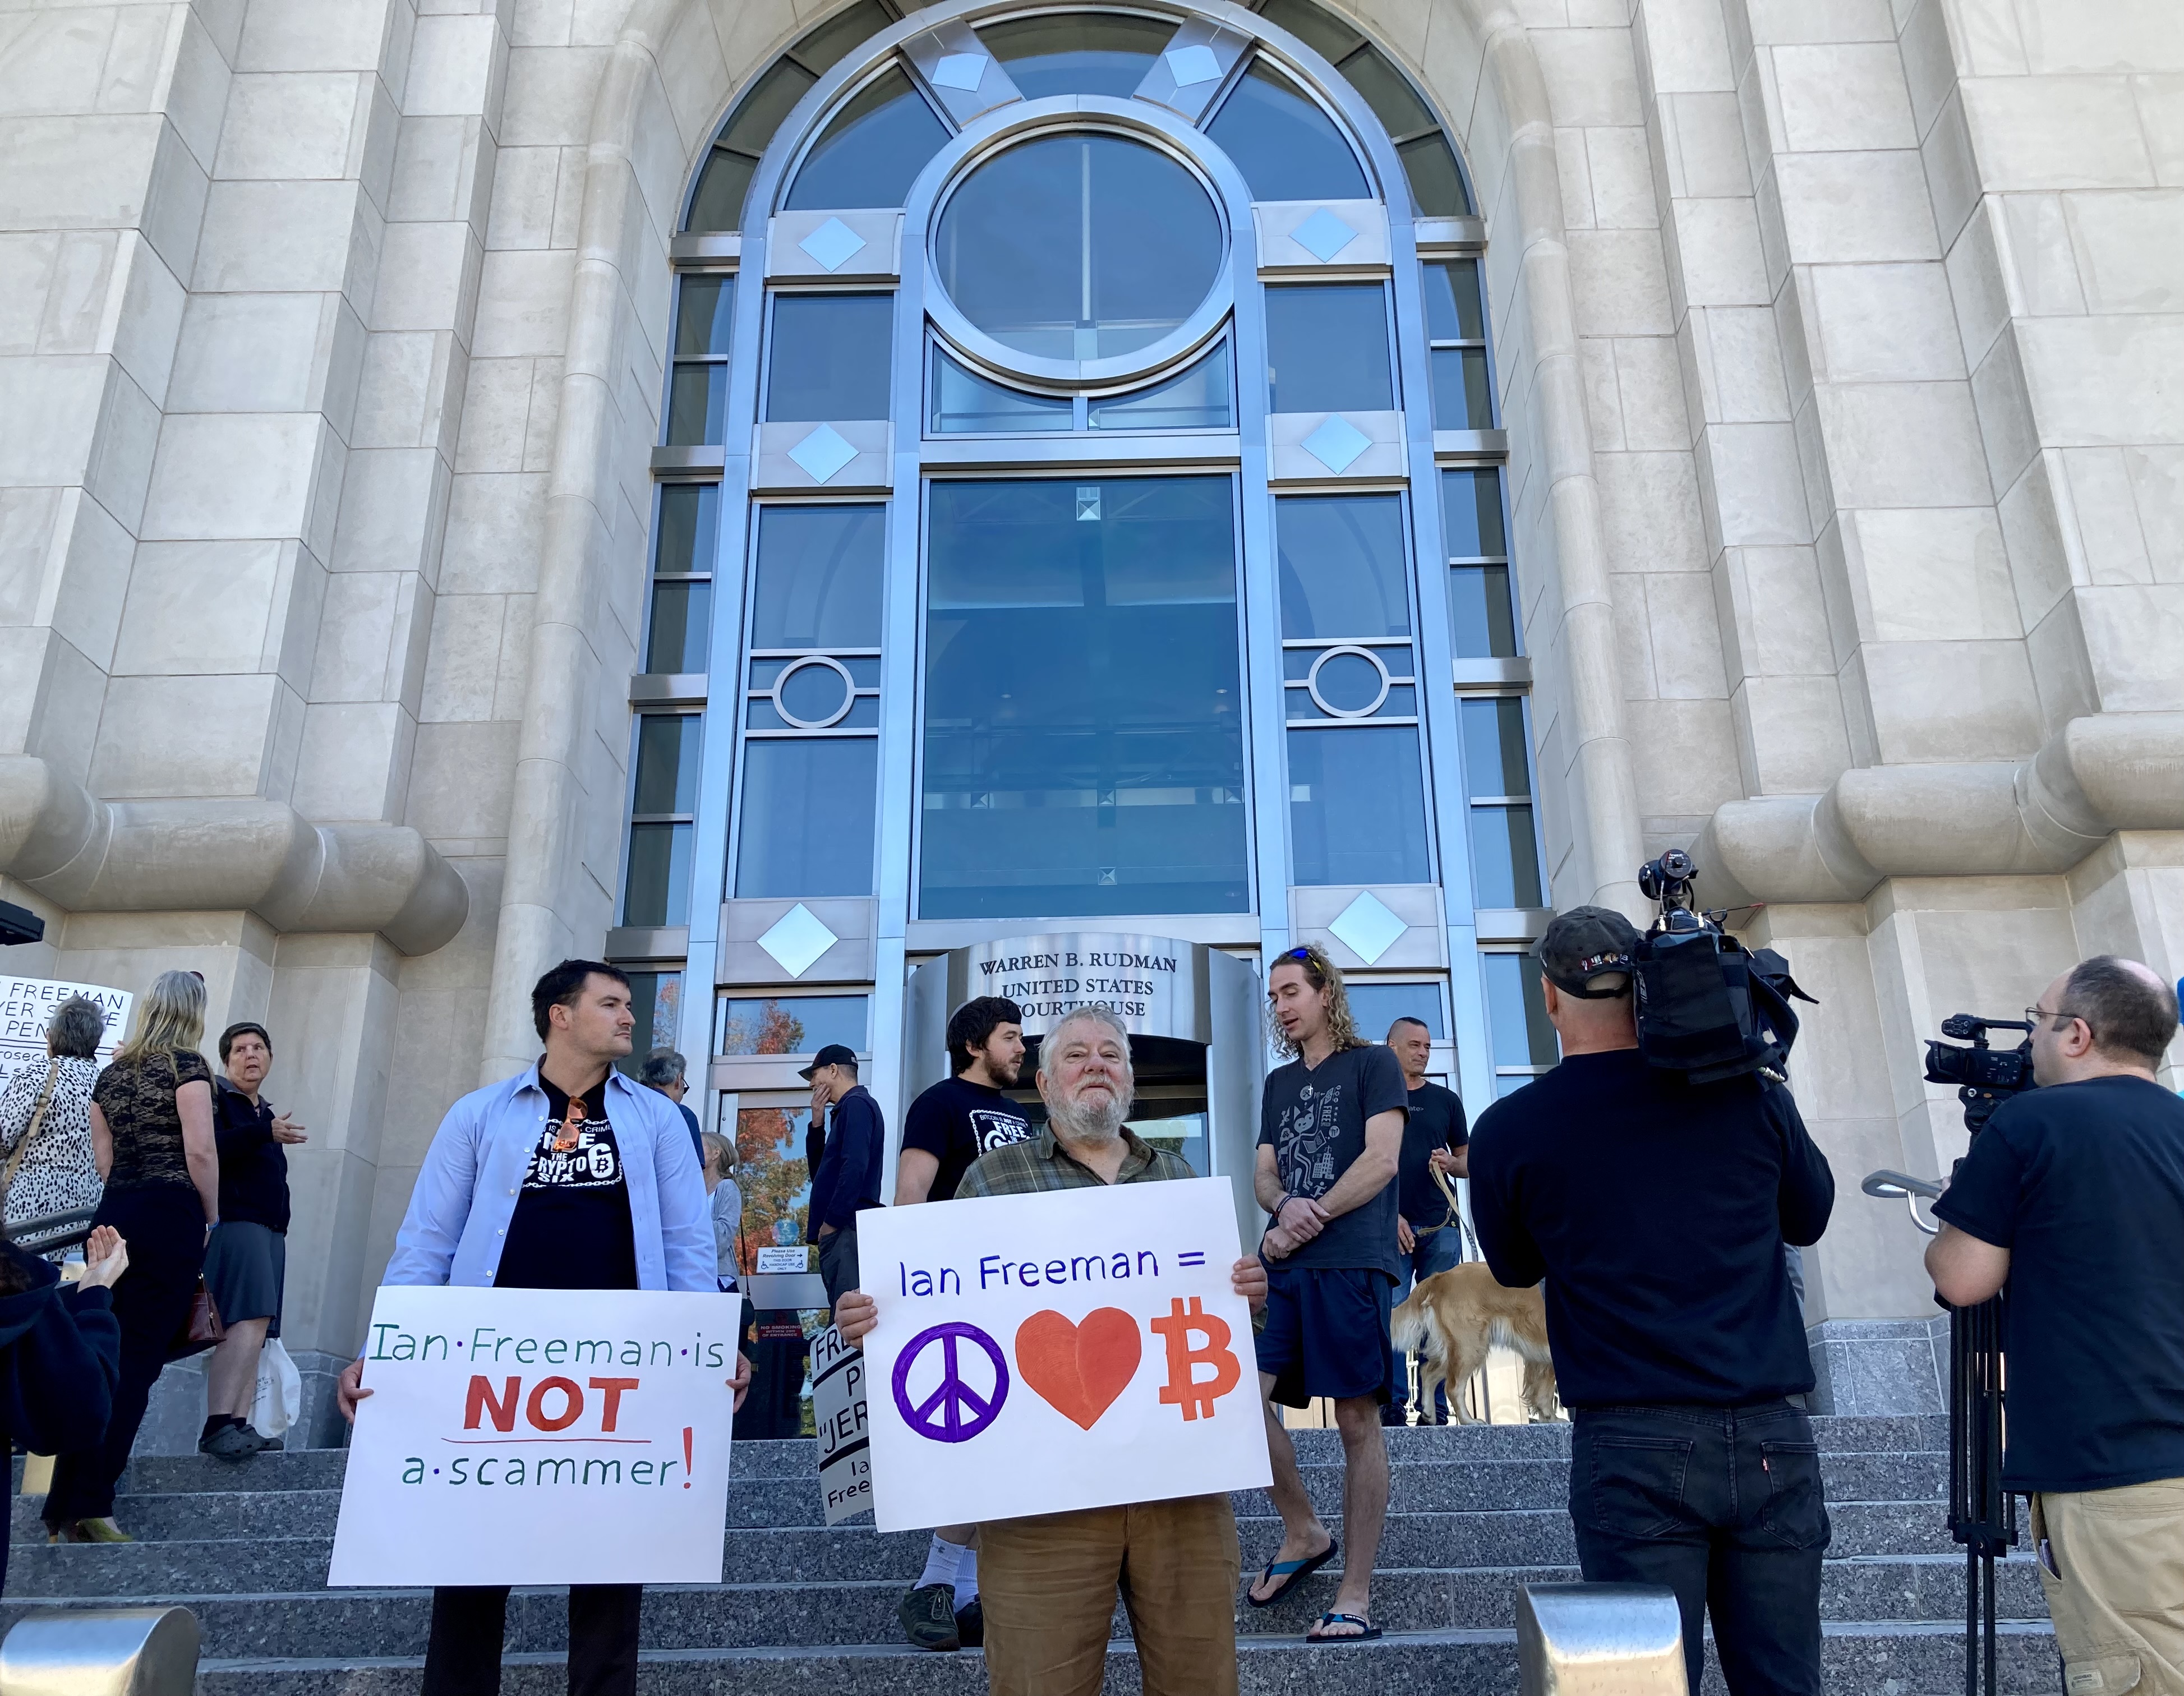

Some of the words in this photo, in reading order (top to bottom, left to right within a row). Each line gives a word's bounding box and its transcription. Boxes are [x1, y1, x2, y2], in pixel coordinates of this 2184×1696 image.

[979, 953, 1059, 975] WARREN
[1065, 952, 1084, 967] B.
[1089, 952, 1177, 973] RUDMAN
[1002, 979, 1080, 998] UNITED
[1085, 978, 1154, 996] STATES
[0, 1001, 34, 1018] ER
[6, 1020, 47, 1038] PEN
[992, 1121, 1027, 1139] FREE
[528, 1154, 587, 1176] RYPTO
[551, 1153, 568, 1162] THE
[537, 1172, 575, 1183] SIX
[899, 1261, 961, 1296] Ian
[979, 1250, 1159, 1290] Freeman
[463, 1375, 640, 1432] NOT
[819, 1400, 868, 1454] "JER
[851, 1460, 869, 1477] Ia
[827, 1480, 870, 1509] Free
